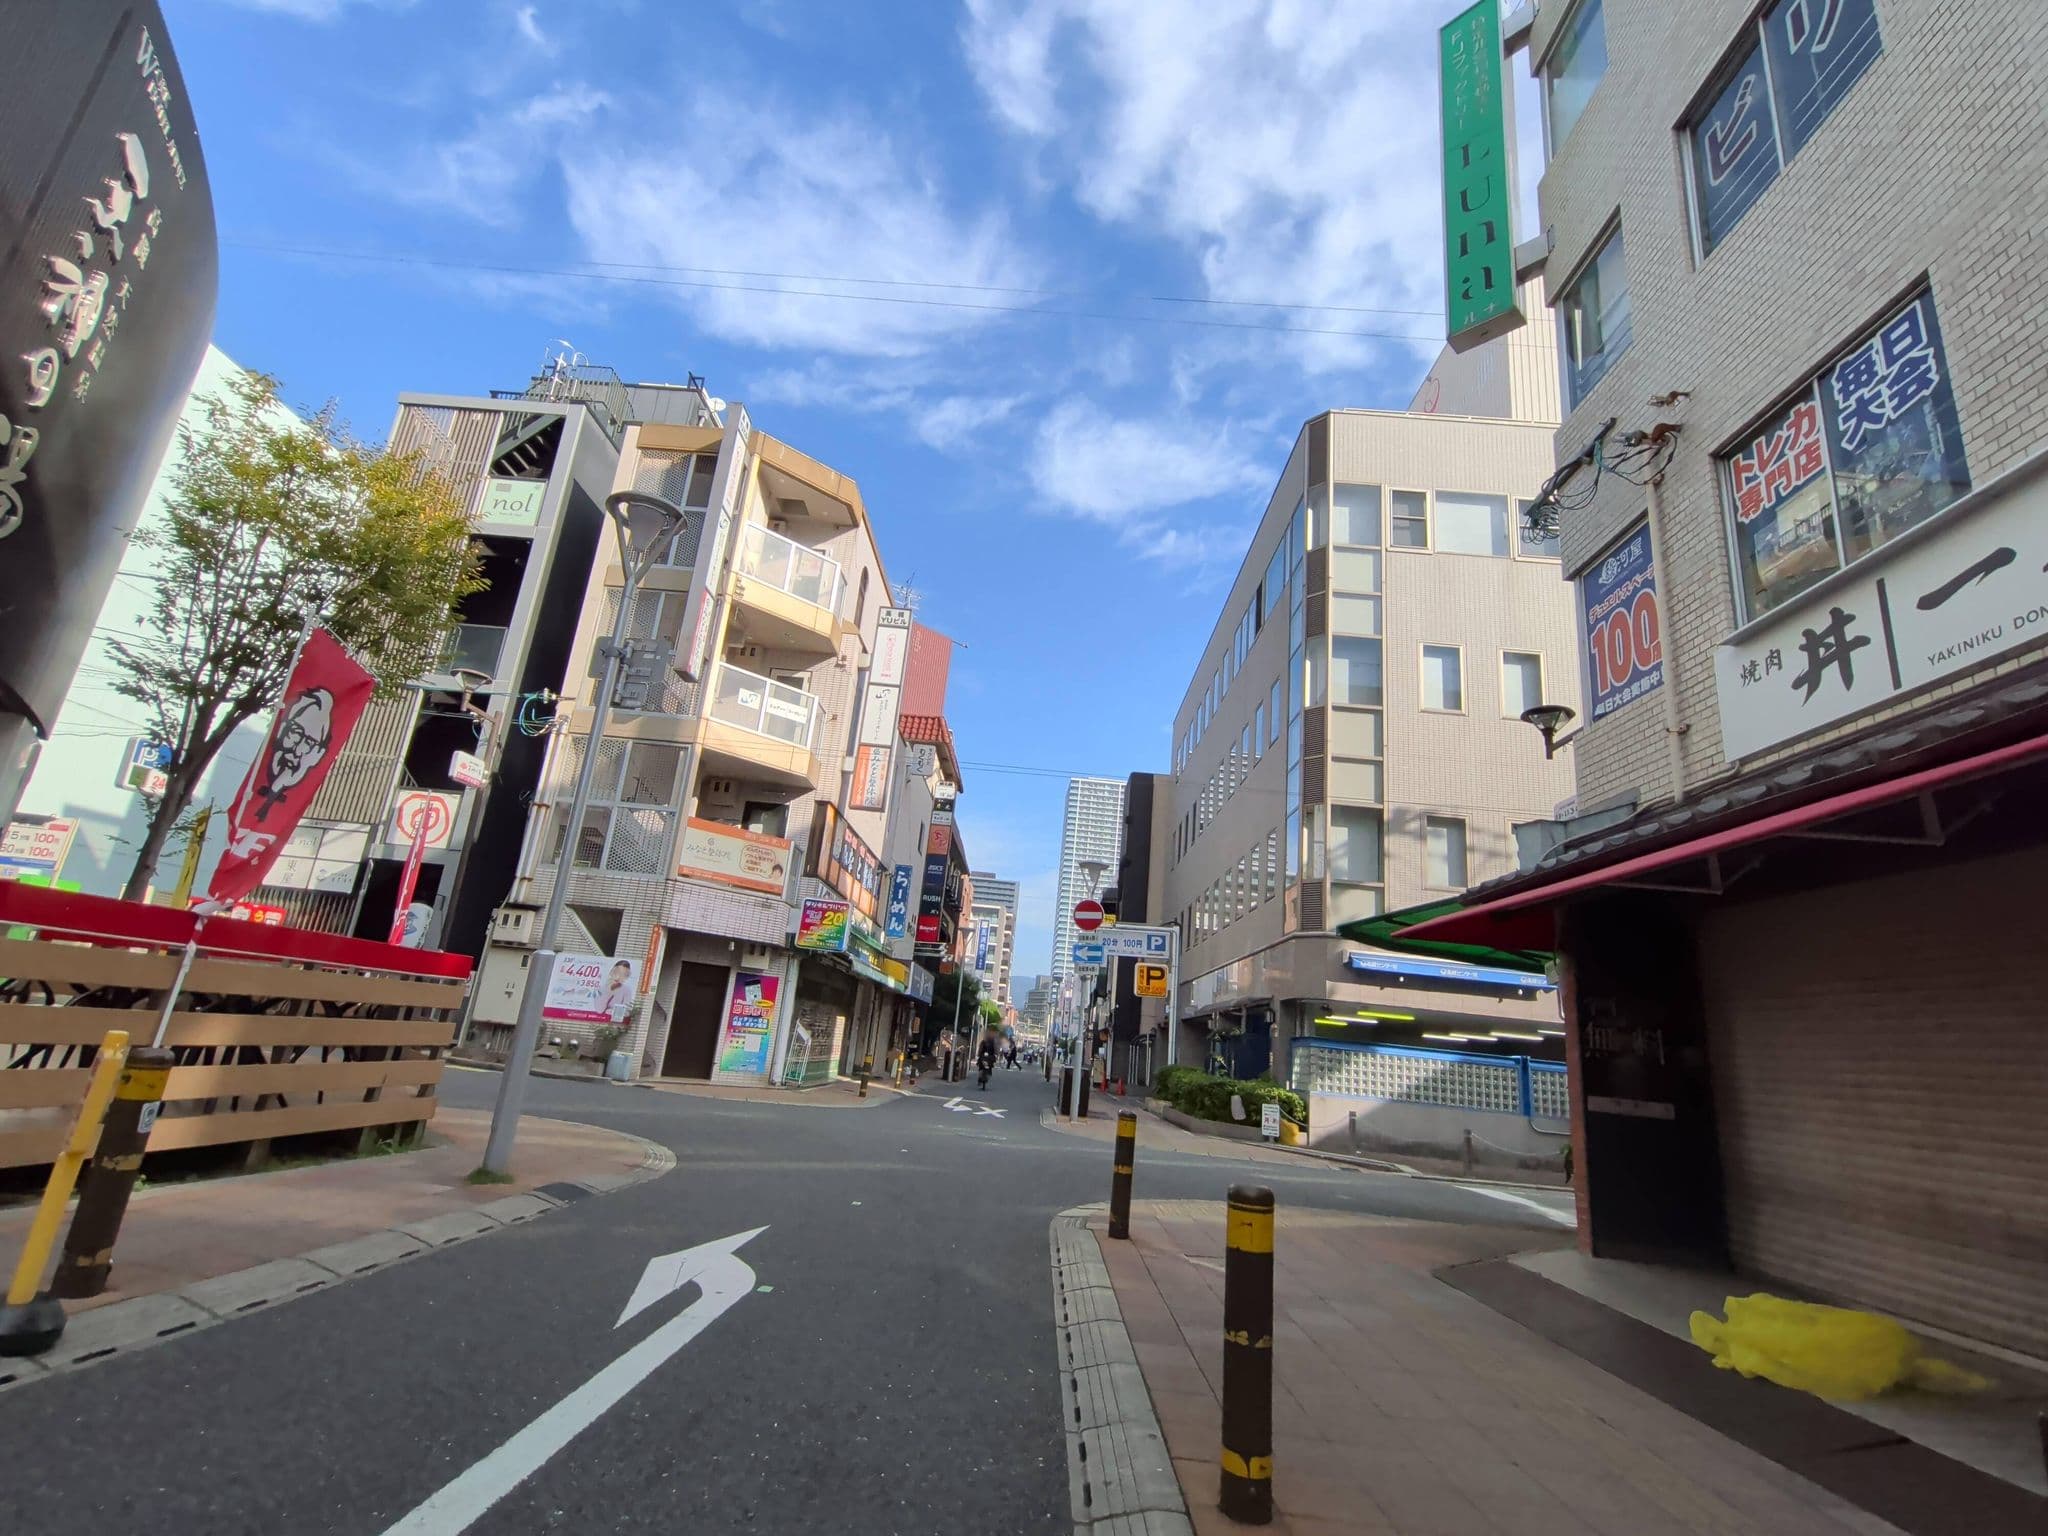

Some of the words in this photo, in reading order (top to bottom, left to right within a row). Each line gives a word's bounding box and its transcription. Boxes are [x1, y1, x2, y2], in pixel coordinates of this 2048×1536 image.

[1458, 143, 1497, 301] Luna
[1832, 300, 1928, 408] 毎日
[1839, 348, 1940, 450] 大会
[1730, 402, 1818, 494] トレカ
[1738, 438, 1827, 523] 専門店
[493, 493, 533, 512] nol
[881, 616, 907, 625] YUビル
[1928, 624, 2003, 667] YAKINIKU
[1740, 649, 1784, 688] 焼肉
[890, 870, 908, 932] らーめん
[1102, 938, 1118, 947] 20分
[1123, 939, 1143, 949] 100円
[1150, 936, 1163, 950] P
[1146, 966, 1166, 987] P
